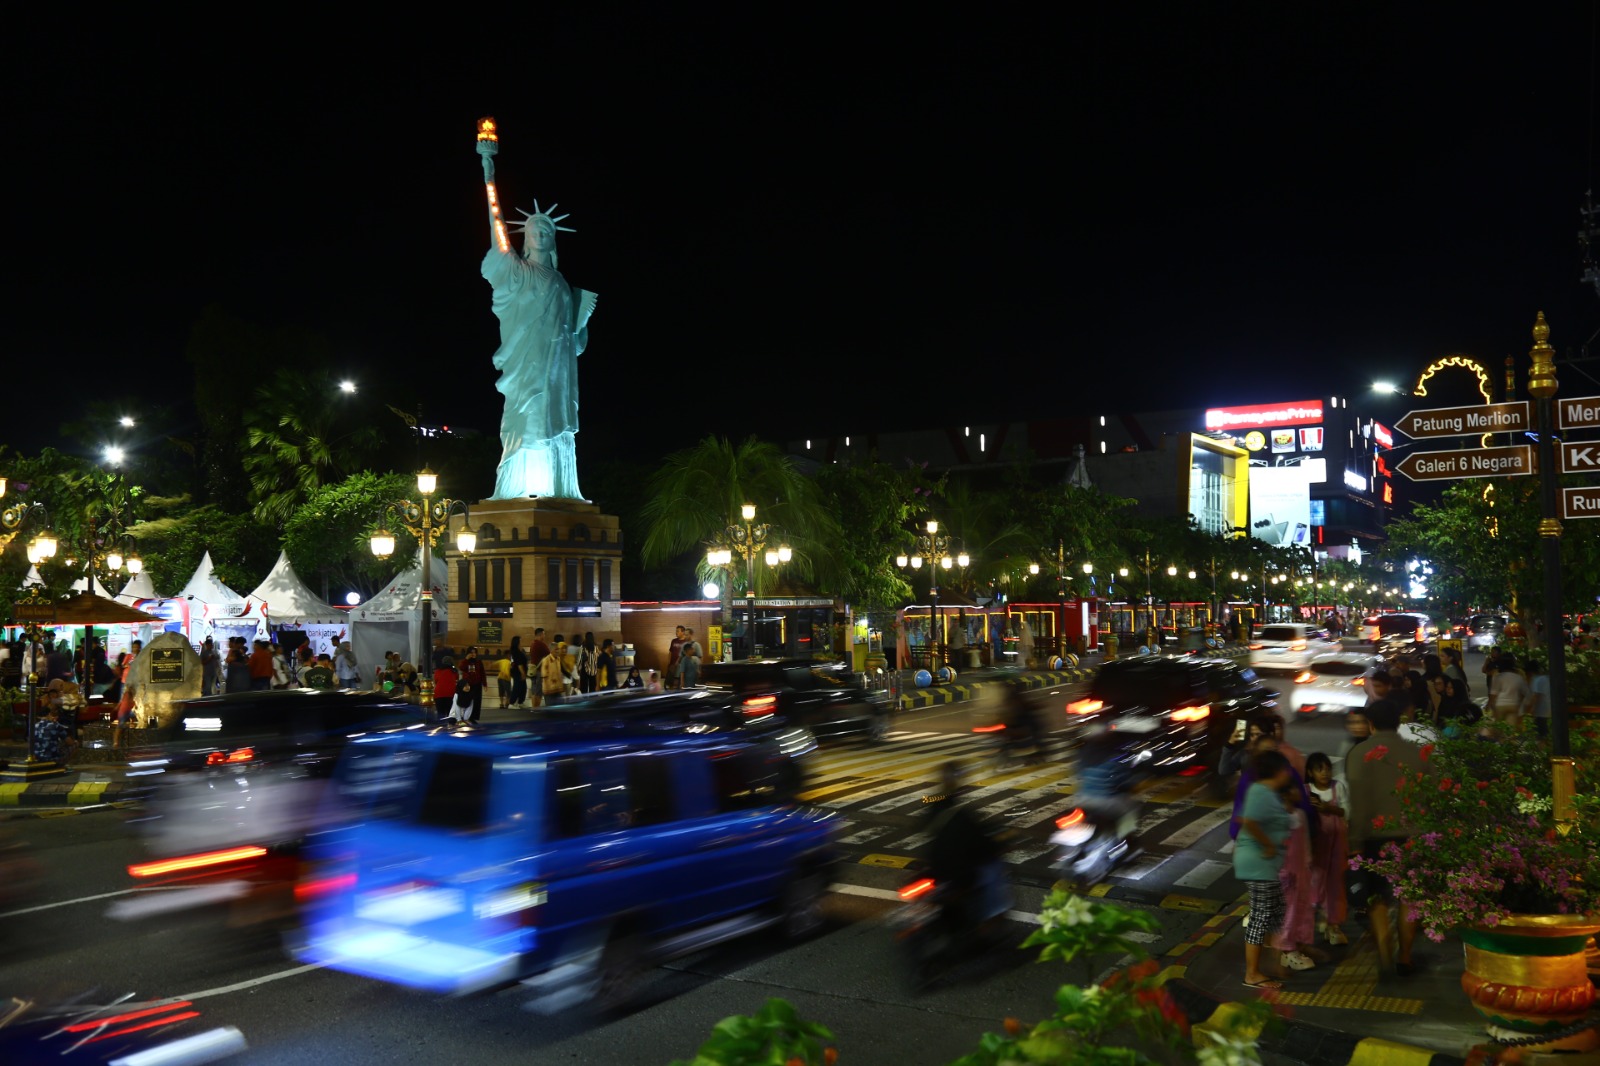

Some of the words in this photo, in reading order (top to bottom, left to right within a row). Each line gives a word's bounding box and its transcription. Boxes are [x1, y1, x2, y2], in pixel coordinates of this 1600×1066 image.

[1413, 417, 1463, 432] Patung
[1466, 411, 1521, 428] Merlion
[1415, 457, 1456, 473] Galeri
[1459, 456, 1468, 471] 6
[1471, 455, 1522, 472] Negara
[1573, 495, 1600, 511] Ru
[308, 629, 338, 639] bankjatim
